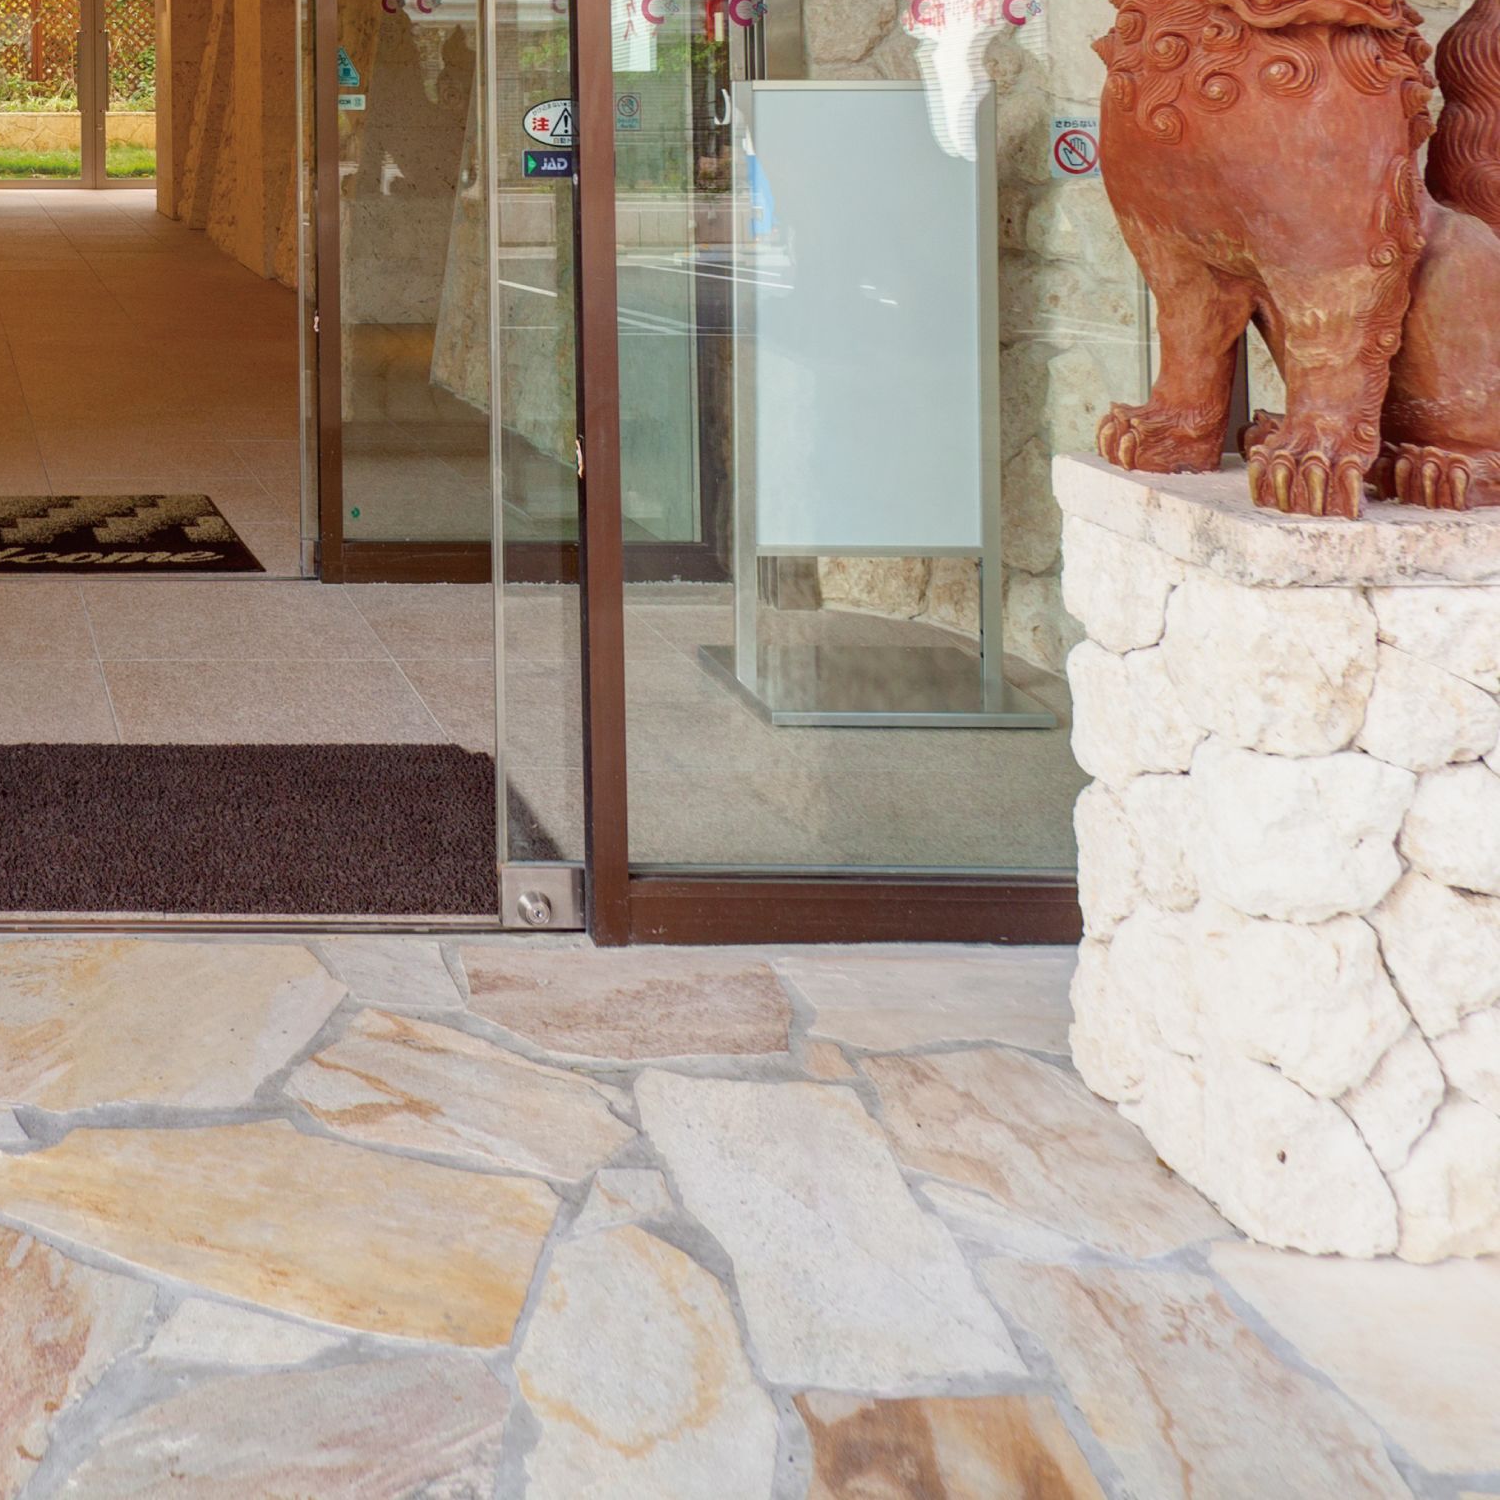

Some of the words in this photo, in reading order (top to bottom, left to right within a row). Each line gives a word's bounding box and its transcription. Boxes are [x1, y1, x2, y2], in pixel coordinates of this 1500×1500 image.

[532, 116, 550, 132] 注
[1055, 120, 1097, 128] さわらない
